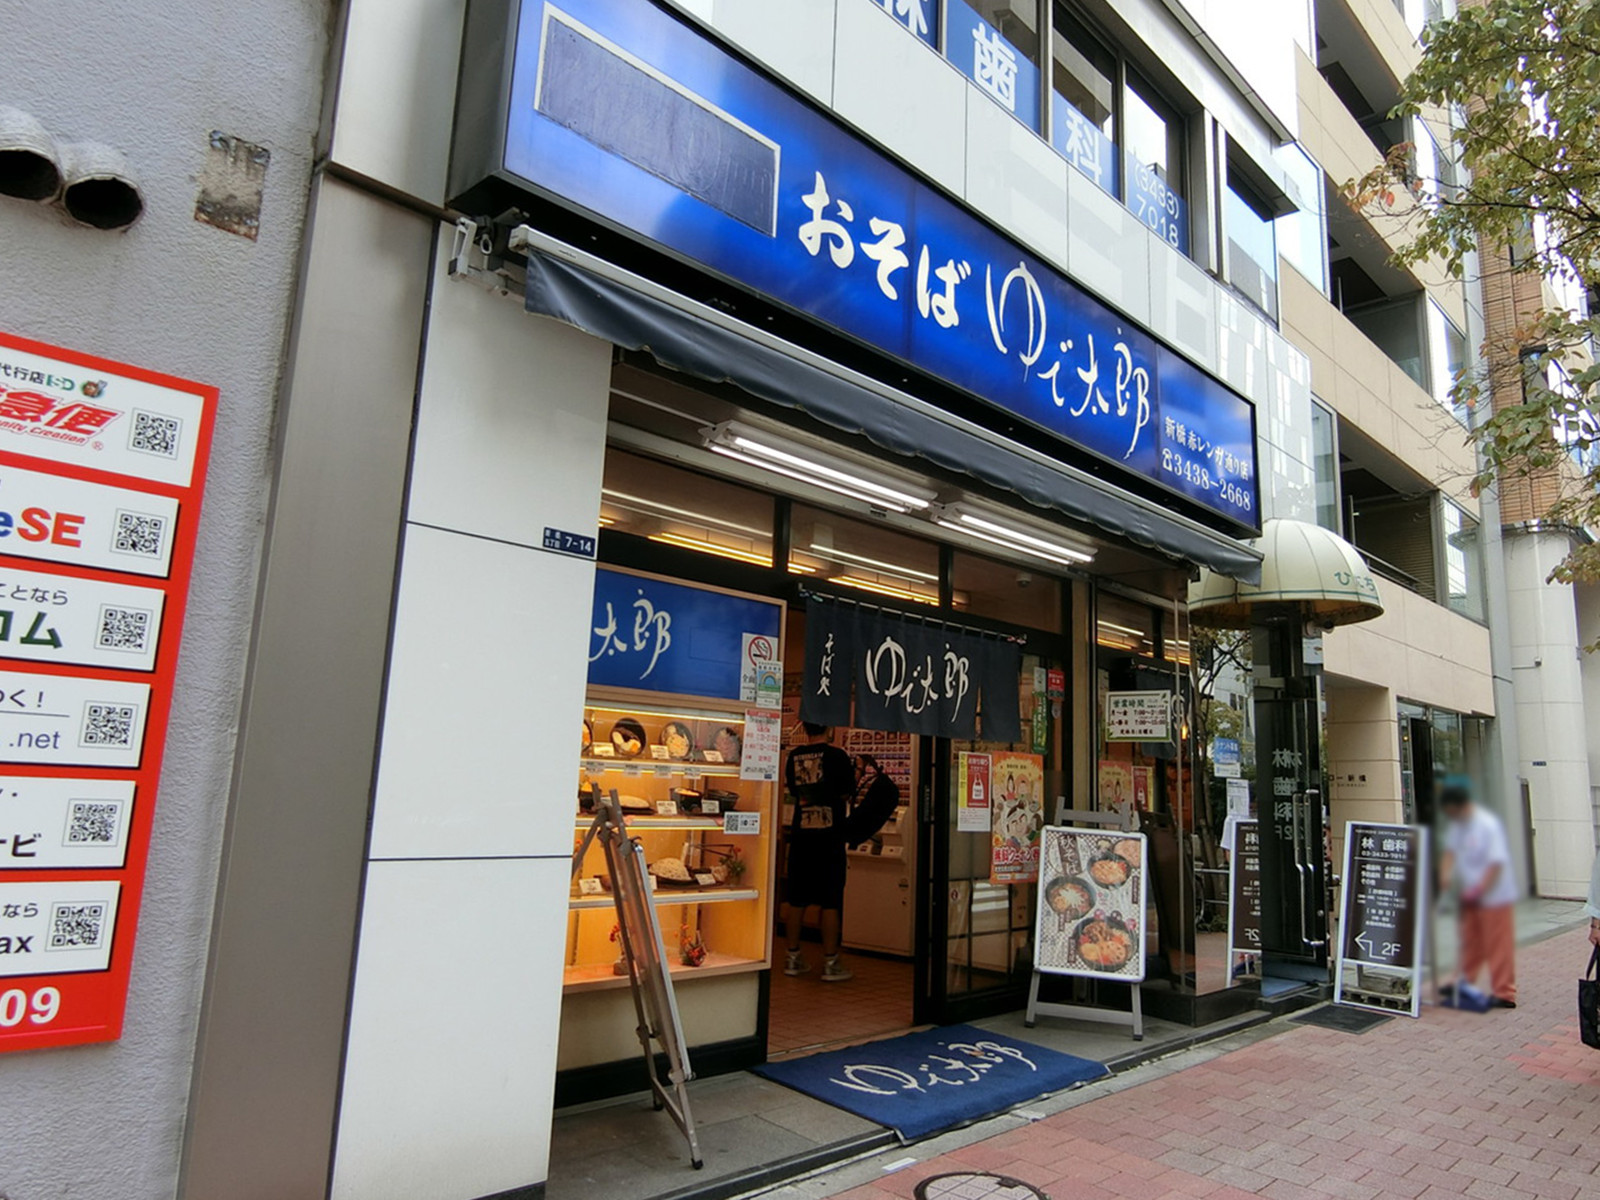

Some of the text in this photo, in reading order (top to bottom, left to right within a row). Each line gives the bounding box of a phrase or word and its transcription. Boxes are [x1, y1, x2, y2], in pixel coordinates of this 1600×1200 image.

[1136, 193, 1180, 248] 7018
[798, 170, 1151, 460] おそば ゆで太郎
[0, 388, 119, 435] 急便
[29, 427, 86, 444] Creation
[1173, 453, 1251, 512] 3438-2668
[565, 535, 592, 552] 7-14
[588, 588, 672, 681] 太郎
[865, 635, 970, 723] ゆで太郎
[1361, 836, 1408, 851] 林 歯科
[1381, 941, 1402, 957] 2F
[0, 986, 61, 1027] 09
[829, 1040, 1038, 1096] ゆで太郎
